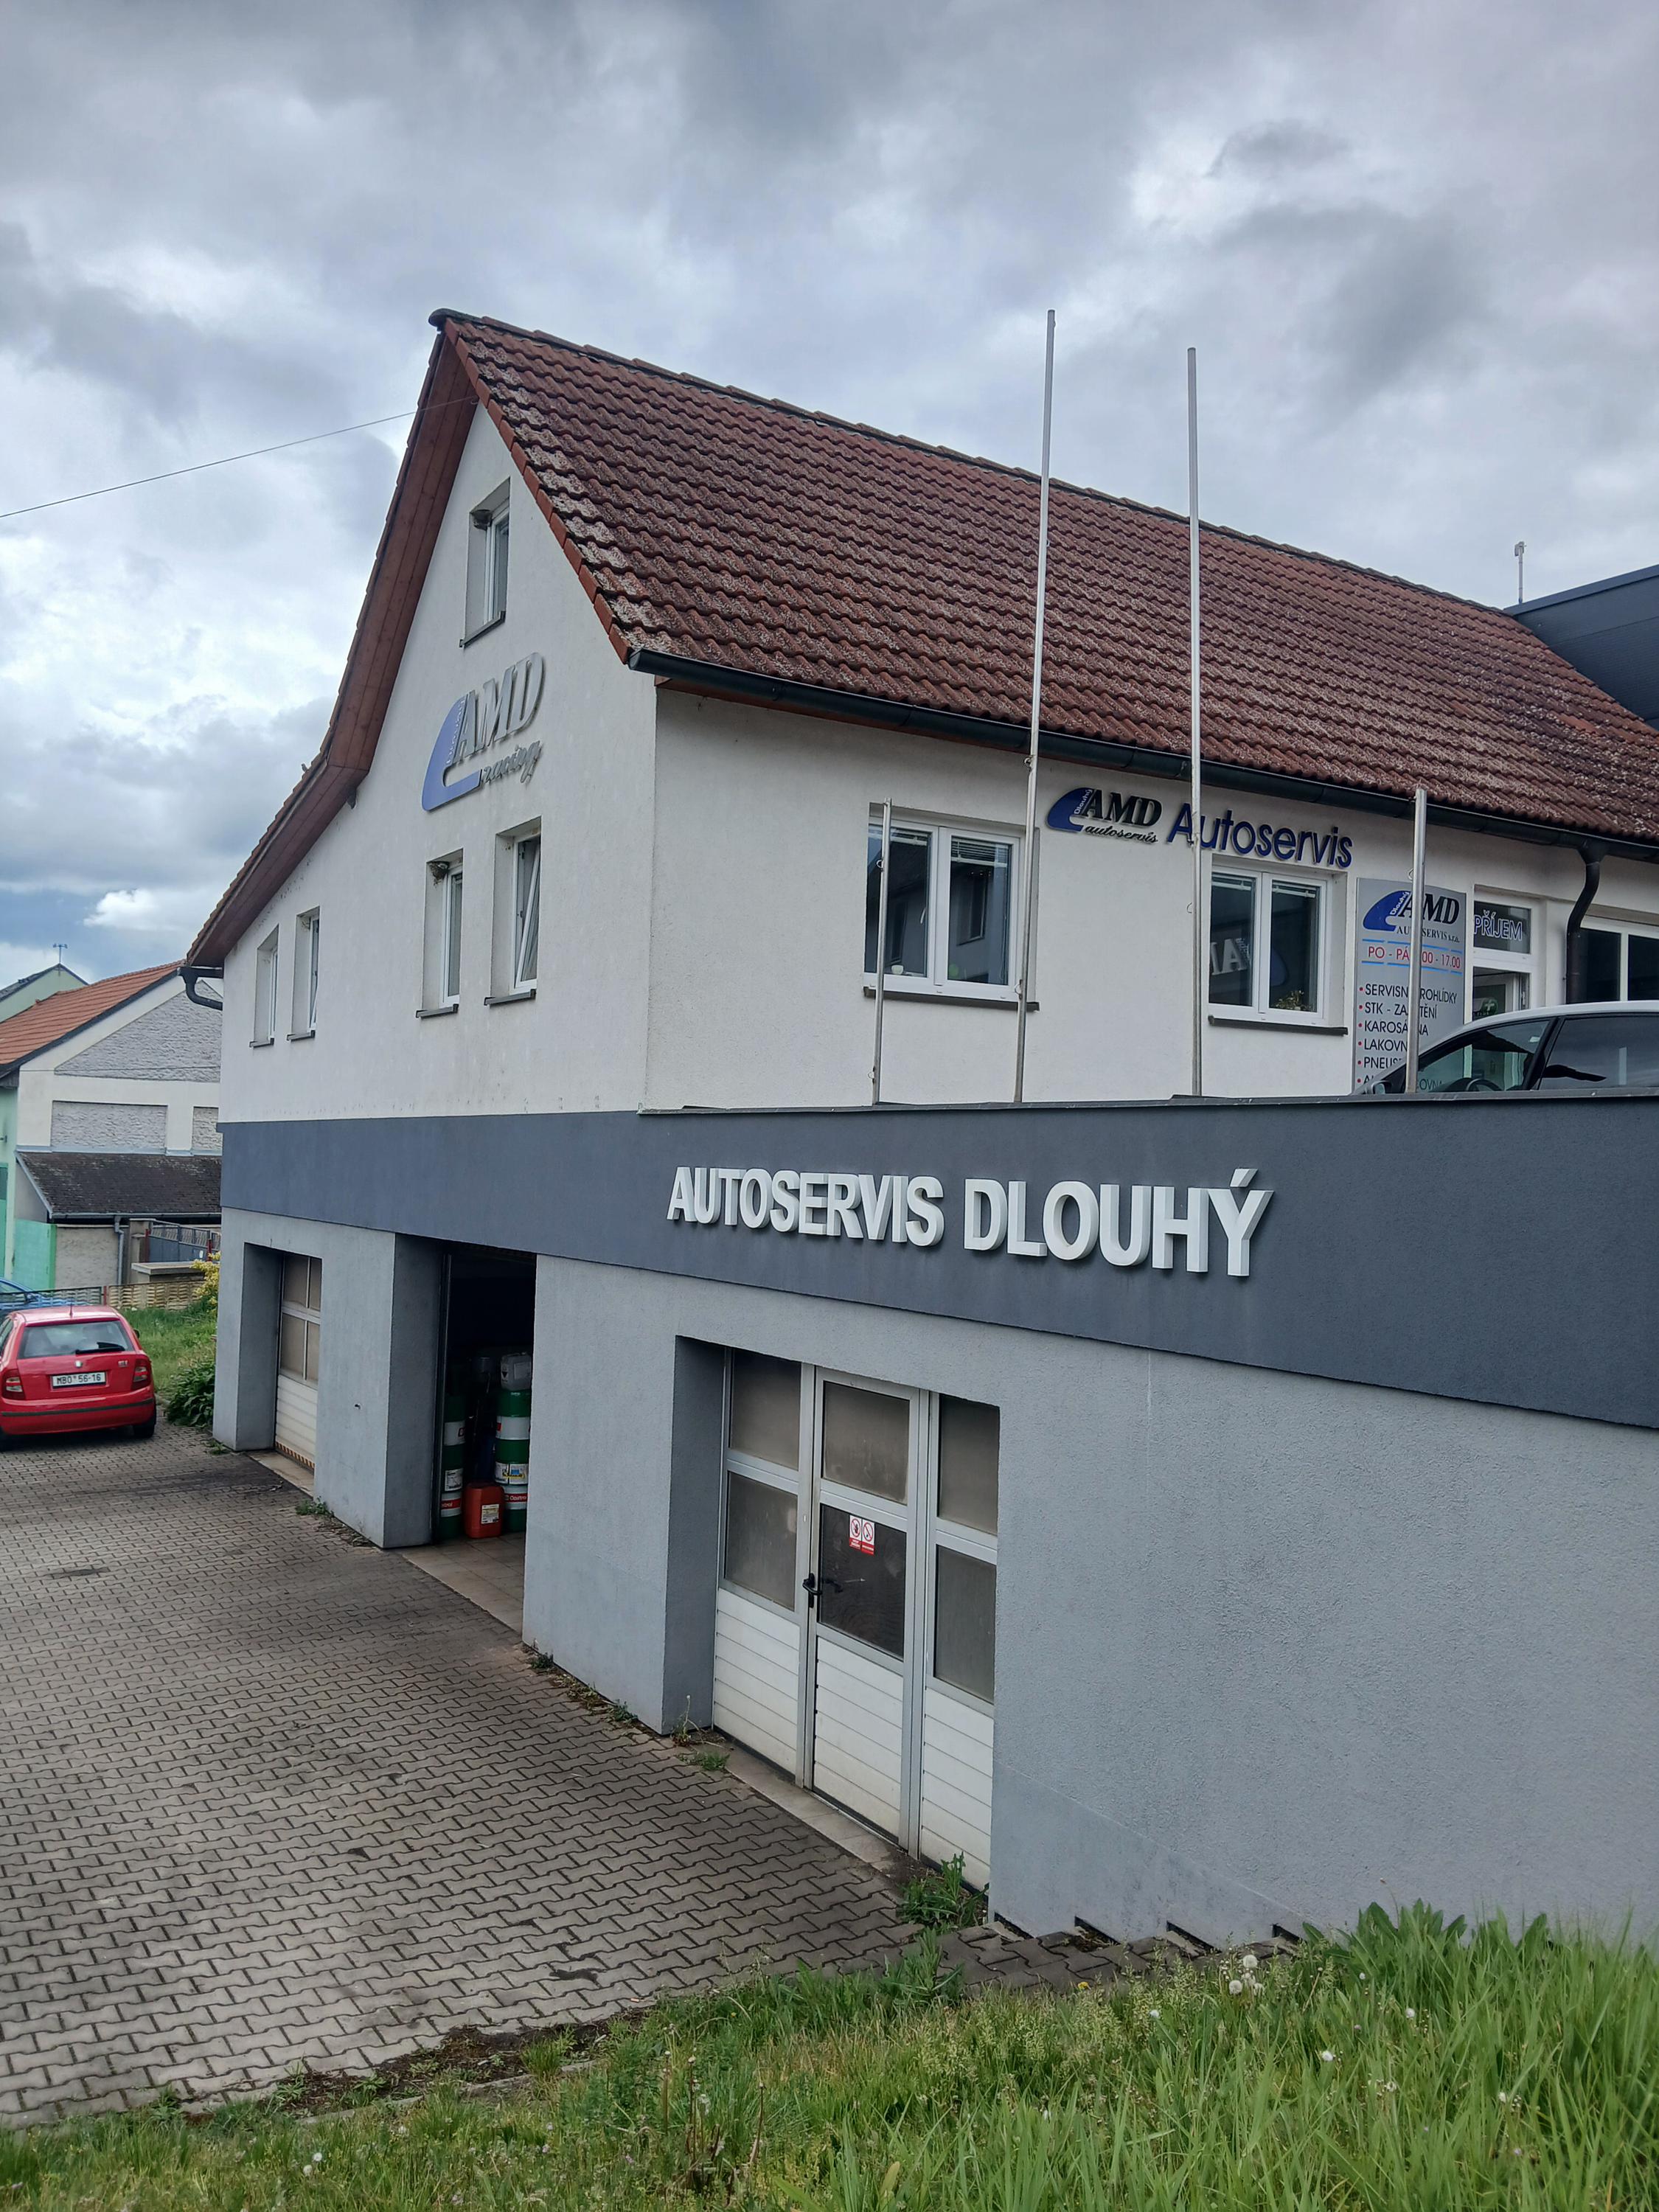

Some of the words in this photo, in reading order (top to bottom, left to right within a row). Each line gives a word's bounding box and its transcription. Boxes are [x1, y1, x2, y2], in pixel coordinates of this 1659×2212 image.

[453, 652, 545, 764] AMD
[1074, 789, 1093, 815] Dlouhý
[1081, 789, 1162, 827] AMD
[1085, 825, 1158, 844] autoservis
[1166, 802, 1353, 869] Autoservis
[1389, 891, 1410, 916] Dlouhý
[1397, 926, 1447, 941] AUSERVIS
[1474, 909, 1523, 942] PŘÍJEM
[1368, 946, 1385, 959] PO
[1396, 945, 1410, 961] PÁ
[1441, 954, 1461, 968] 17.00
[1365, 984, 1409, 998] SERVISN
[1419, 987, 1458, 1004] ROHLÍDKY
[1365, 1002, 1383, 1015] STK
[1364, 1019, 1429, 1036] KAROSÁNA
[1364, 1038, 1408, 1052] LAKOVN
[667, 1166, 945, 1248] AUTOSERVIS
[964, 1168, 1274, 1278] DLOUHÝ
[78, 1374, 101, 1382] 56-16
